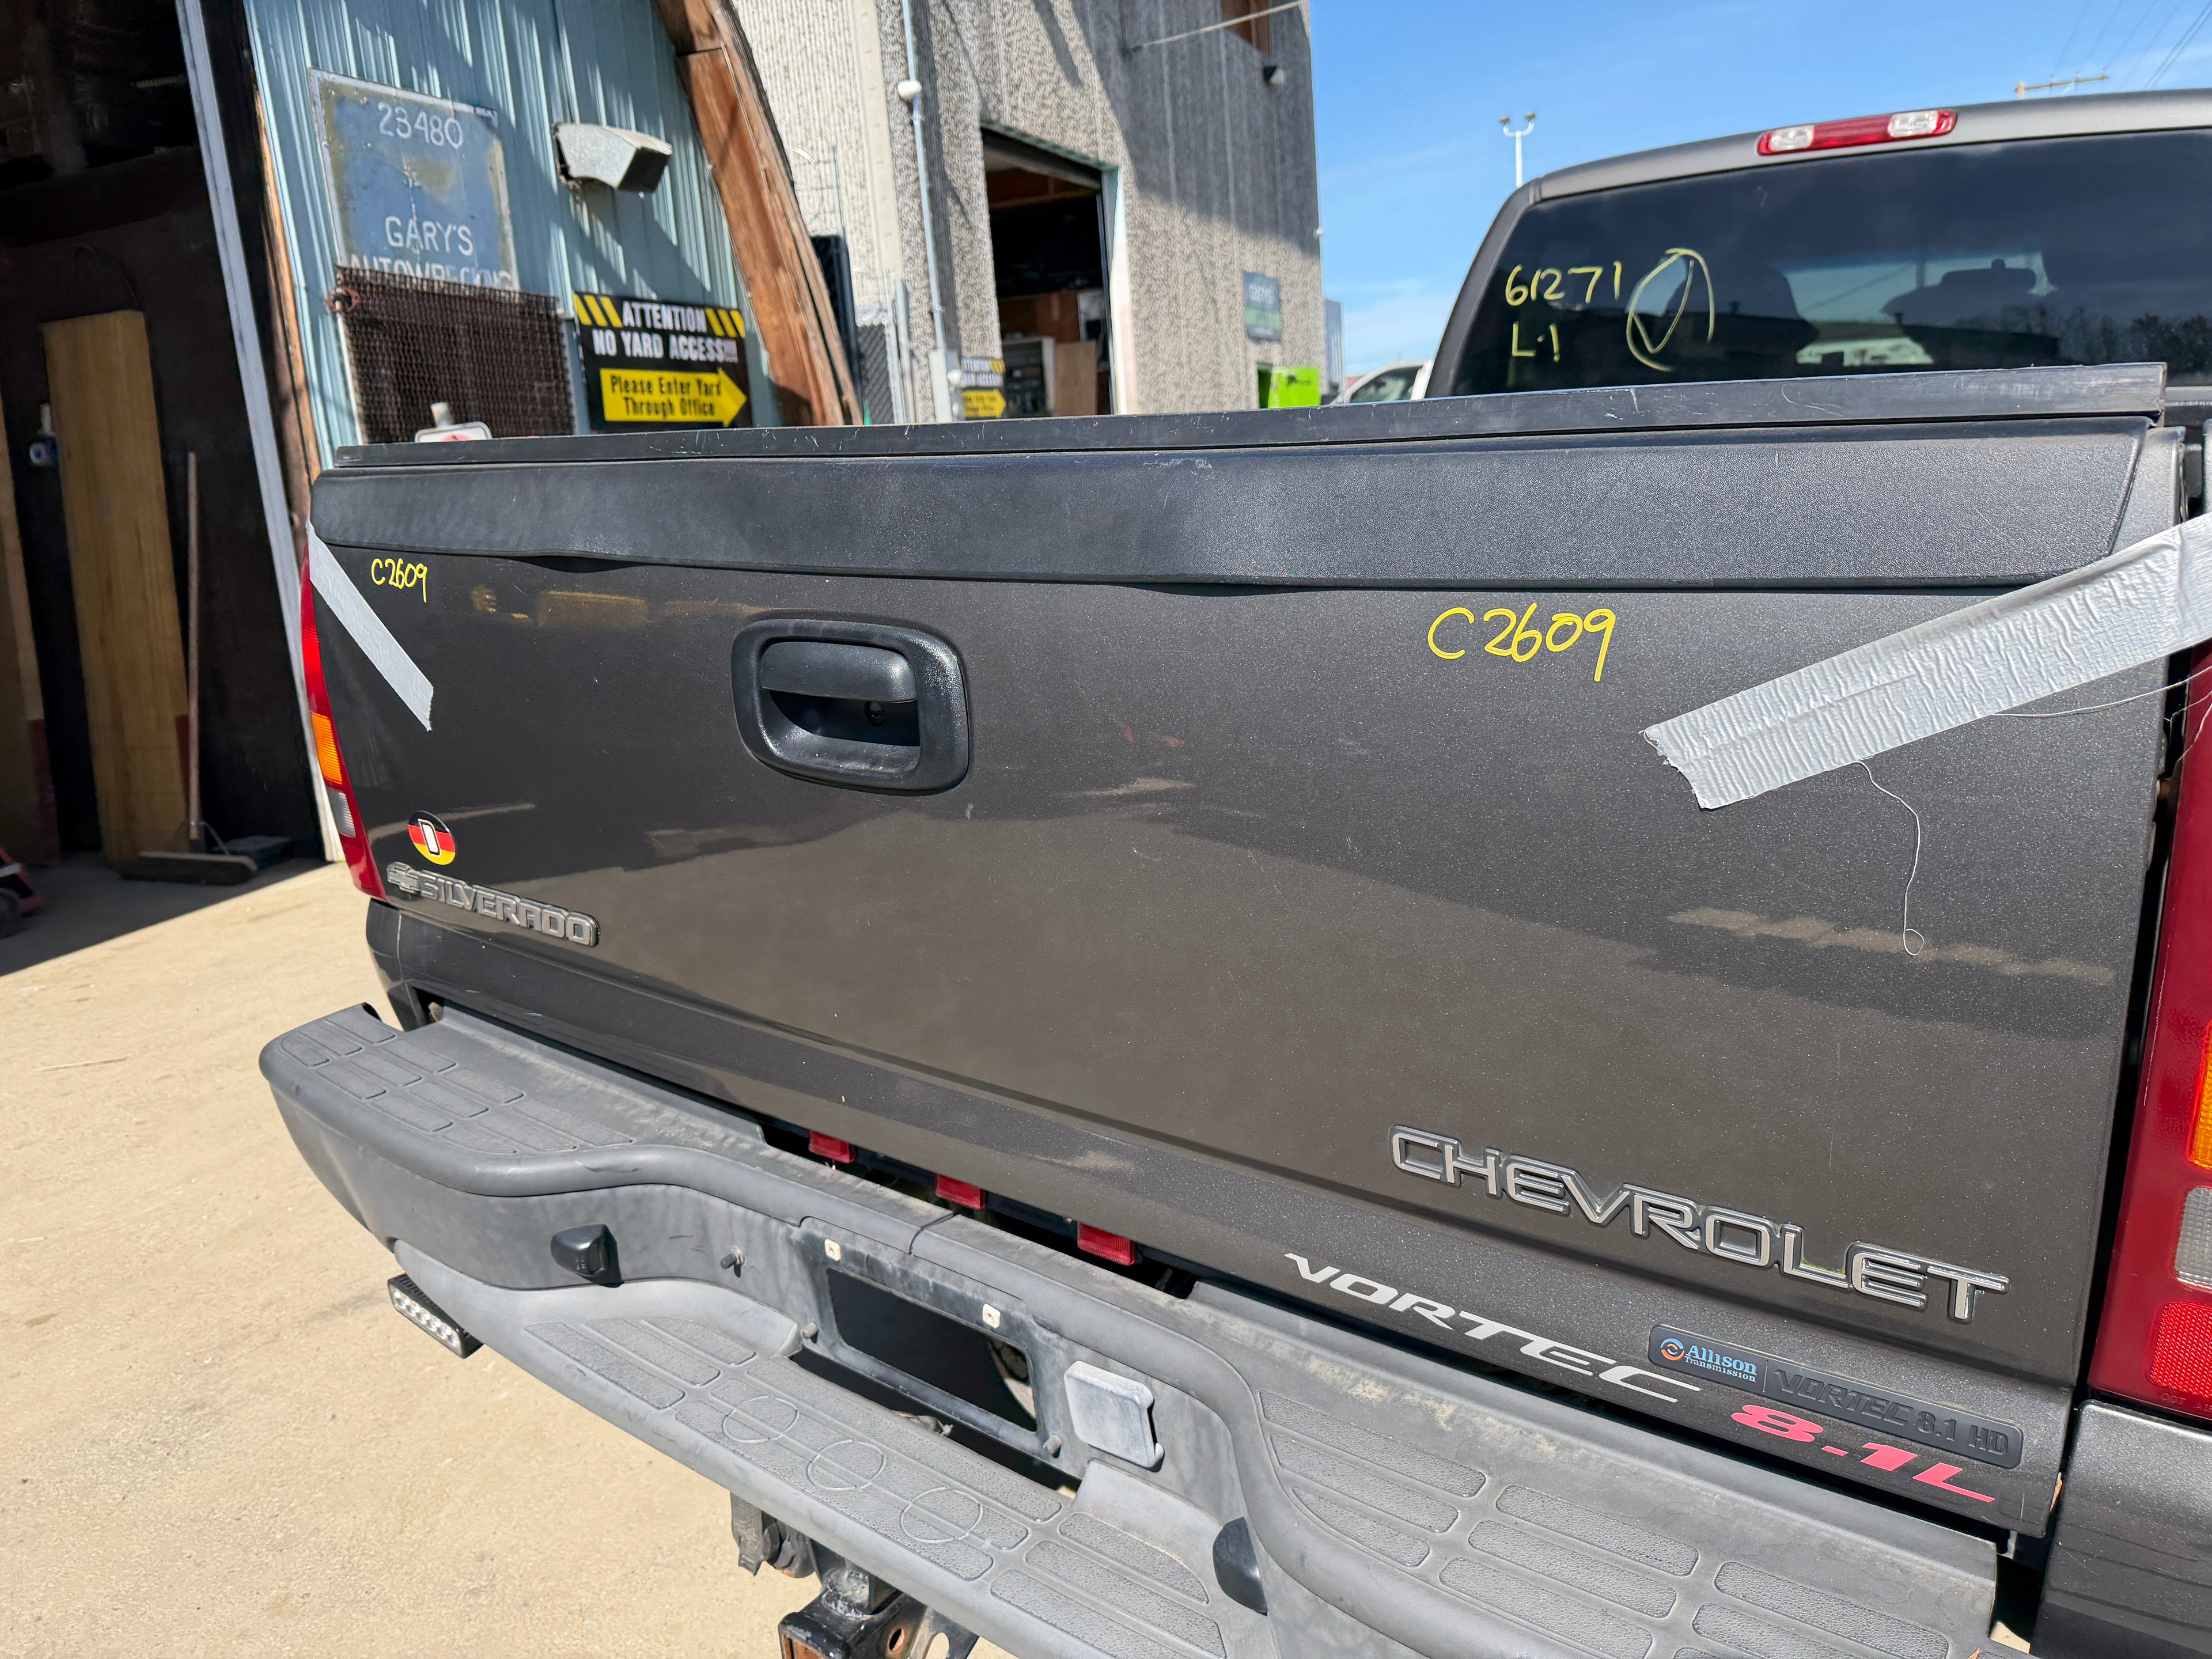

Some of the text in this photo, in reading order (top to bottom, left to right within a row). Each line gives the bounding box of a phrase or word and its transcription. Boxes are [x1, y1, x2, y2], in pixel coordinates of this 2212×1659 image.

[378, 102, 463, 149] 23480
[385, 216, 474, 256] GARY'S
[1505, 261, 1622, 306] 61271
[622, 300, 708, 333] ATTENTION
[592, 328, 618, 357] NO
[620, 330, 664, 358] YARD
[611, 375, 721, 397] Please Enter Yard
[624, 396, 715, 419] Through Office
[371, 558, 427, 603] C2609
[418, 870, 600, 947] SILVERADO
[1389, 1125, 2010, 1323] CHEVROLET
[1284, 1252, 1701, 1404] VORTEC
[1684, 1355, 1756, 1382] Transmission
[1685, 1344, 1758, 1376] Allison
[1775, 1369, 2009, 1456] VORTEC 8.1 HD
